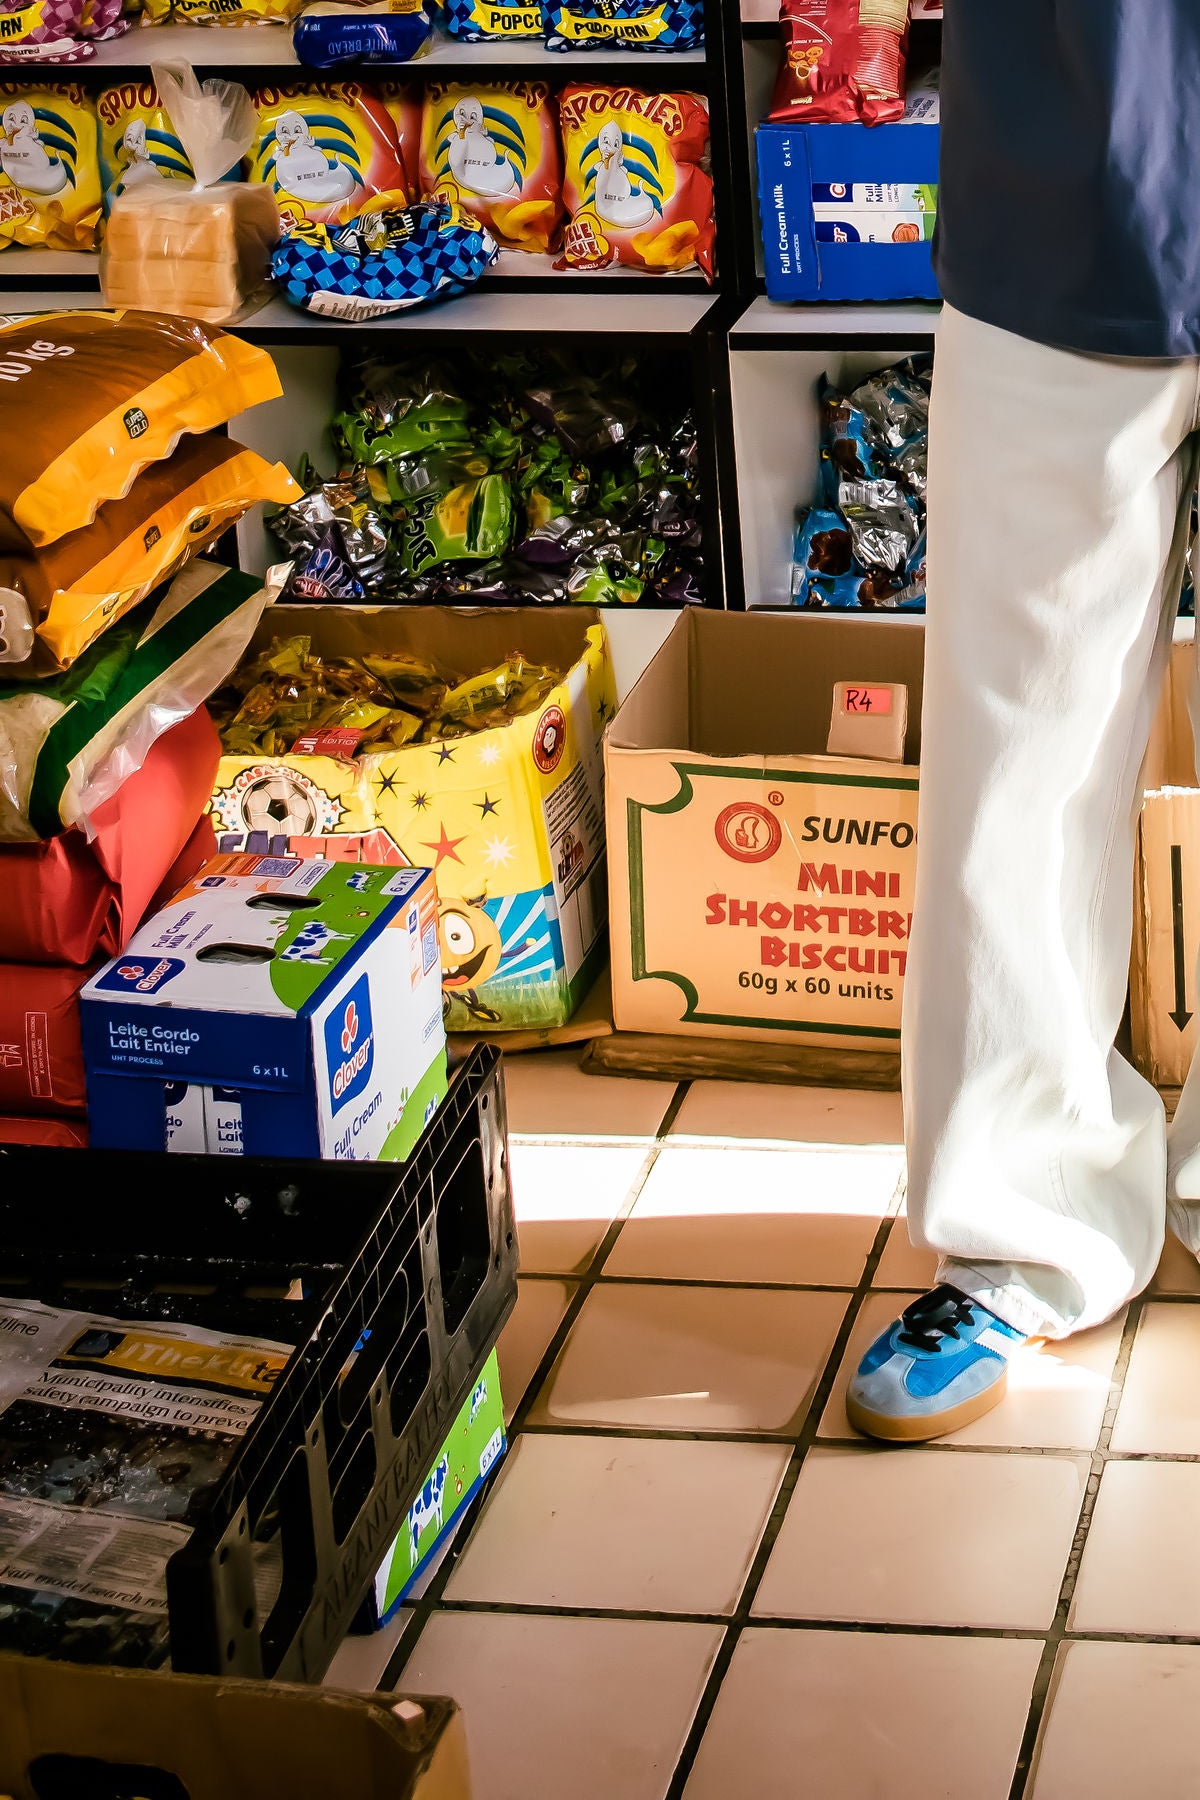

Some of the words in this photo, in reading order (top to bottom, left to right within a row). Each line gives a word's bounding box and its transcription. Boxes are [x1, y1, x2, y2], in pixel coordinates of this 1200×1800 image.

[573, 22, 651, 41] POPCORN
[560, 87, 684, 137] SPOOKIES
[773, 183, 785, 210] Milk
[777, 211, 789, 251] Cream
[781, 253, 791, 274] Full
[845, 688, 873, 713] R4
[797, 861, 901, 899] MINI
[737, 971, 779, 996] 60g
[785, 978, 798, 993] x
[804, 976, 831, 995] 60
[838, 978, 894, 1001] units
[109, 1021, 148, 1038] Leite
[151, 1025, 201, 1043] Gordo
[110, 1036, 141, 1051] Lait
[144, 1039, 191, 1056] Entier
[37, 1370, 152, 1399] Municipality
[153, 1387, 250, 1416] intensifies
[23, 1385, 77, 1406] safety
[78, 1394, 171, 1420] campaign
[173, 1408, 192, 1422] to
[194, 1412, 249, 1433] preve
